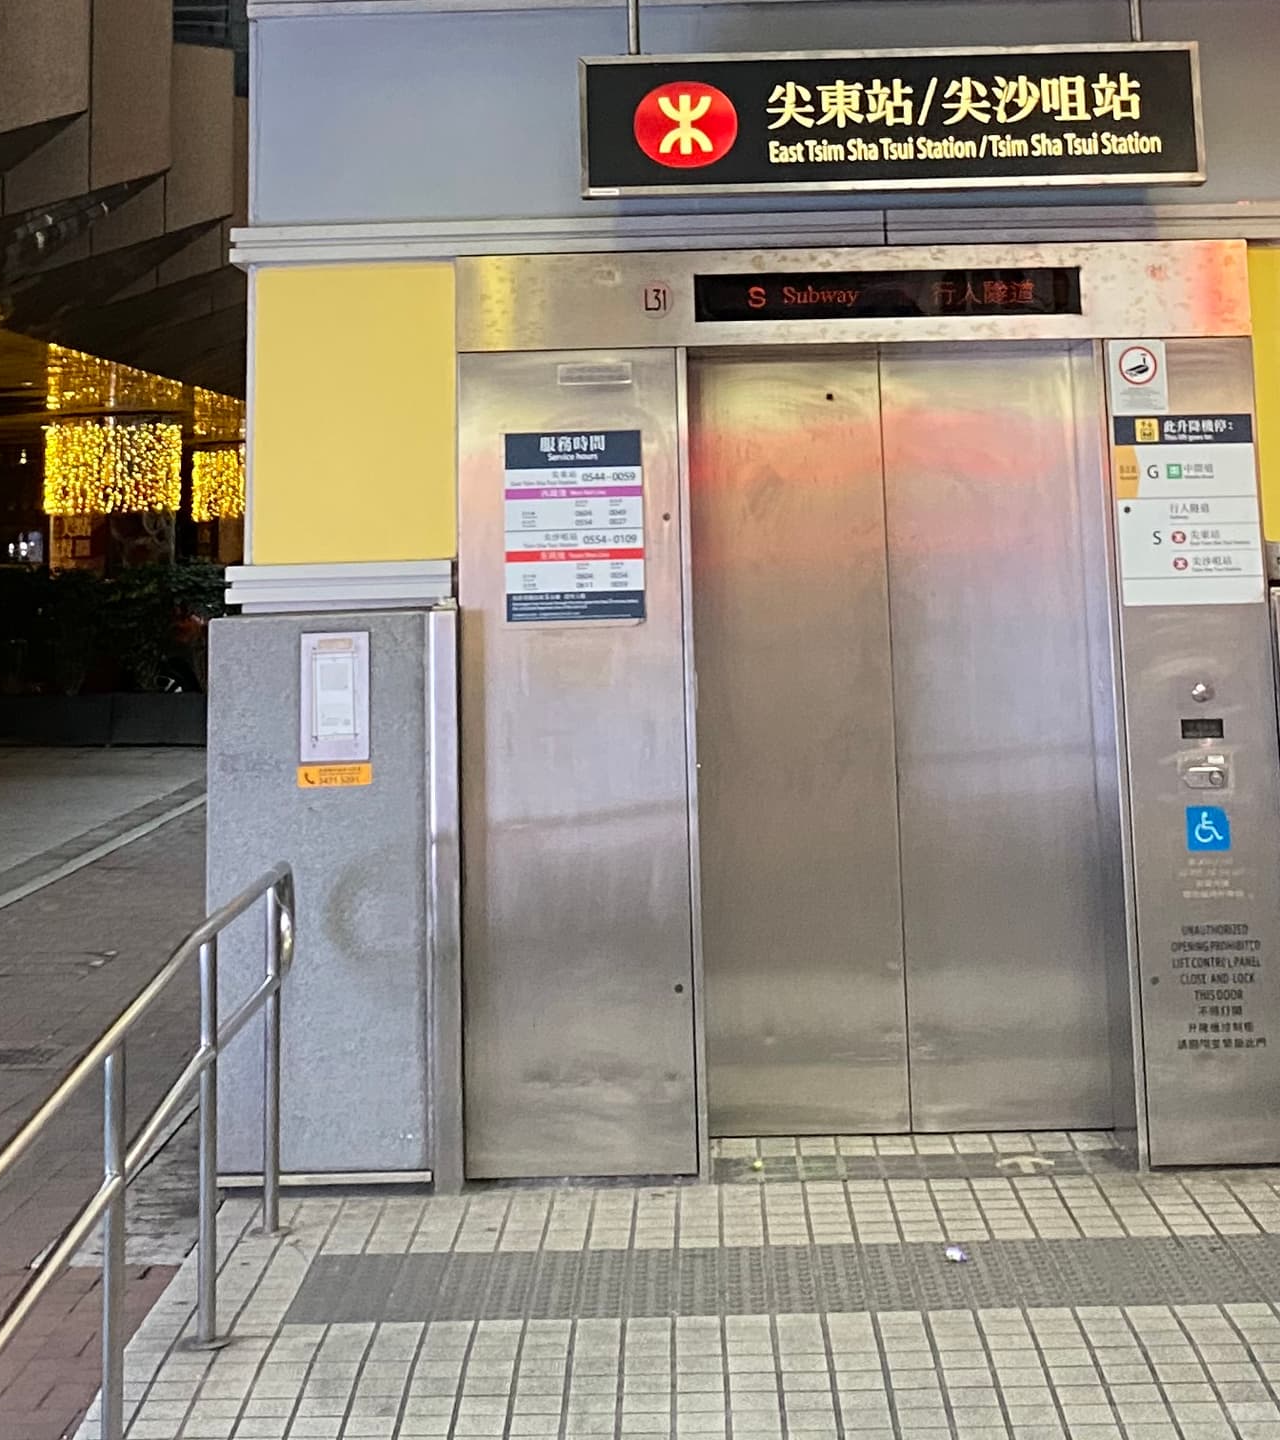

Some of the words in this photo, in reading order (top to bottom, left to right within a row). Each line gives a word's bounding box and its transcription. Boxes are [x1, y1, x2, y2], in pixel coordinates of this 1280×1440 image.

[766, 73, 1142, 129] 尖東站/尖沙咀站
[768, 140, 805, 163] East
[805, 139, 845, 162] Tsim
[847, 138, 879, 161] Sha
[879, 136, 914, 160] Tsui
[917, 136, 977, 160] Station
[988, 134, 1029, 157] Tsim
[1031, 133, 1063, 157] Sha
[1063, 132, 1099, 156] Tsui
[1101, 131, 1162, 155] Station
[644, 288, 667, 311] L31
[748, 286, 766, 308] S
[783, 285, 859, 308] Subway
[1147, 464, 1159, 479] G
[1152, 530, 1162, 545] S
